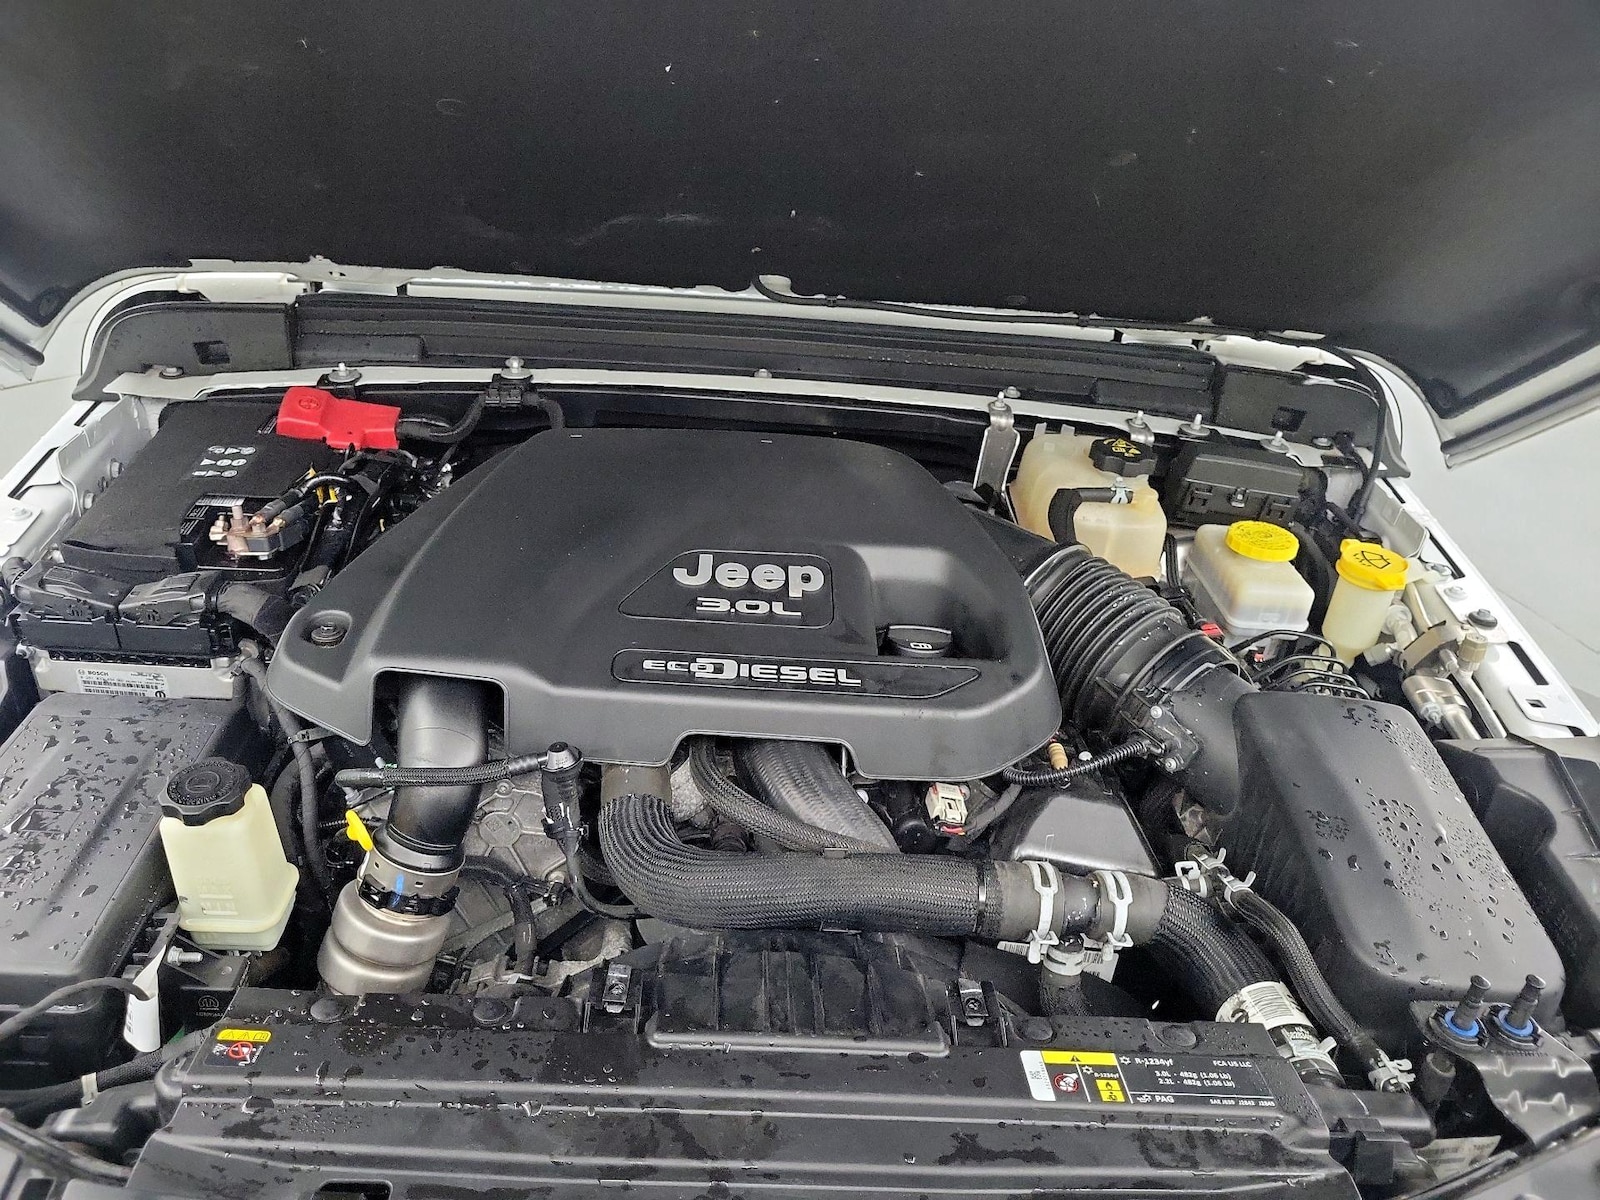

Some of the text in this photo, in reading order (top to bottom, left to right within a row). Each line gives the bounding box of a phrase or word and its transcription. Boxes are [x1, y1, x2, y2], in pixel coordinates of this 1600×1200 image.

[672, 554, 825, 599] Jeep
[695, 597, 802, 617] 3.0L
[1134, 1057, 1174, 1066] R-1234yf
[1154, 1095, 1175, 1103] PAG
